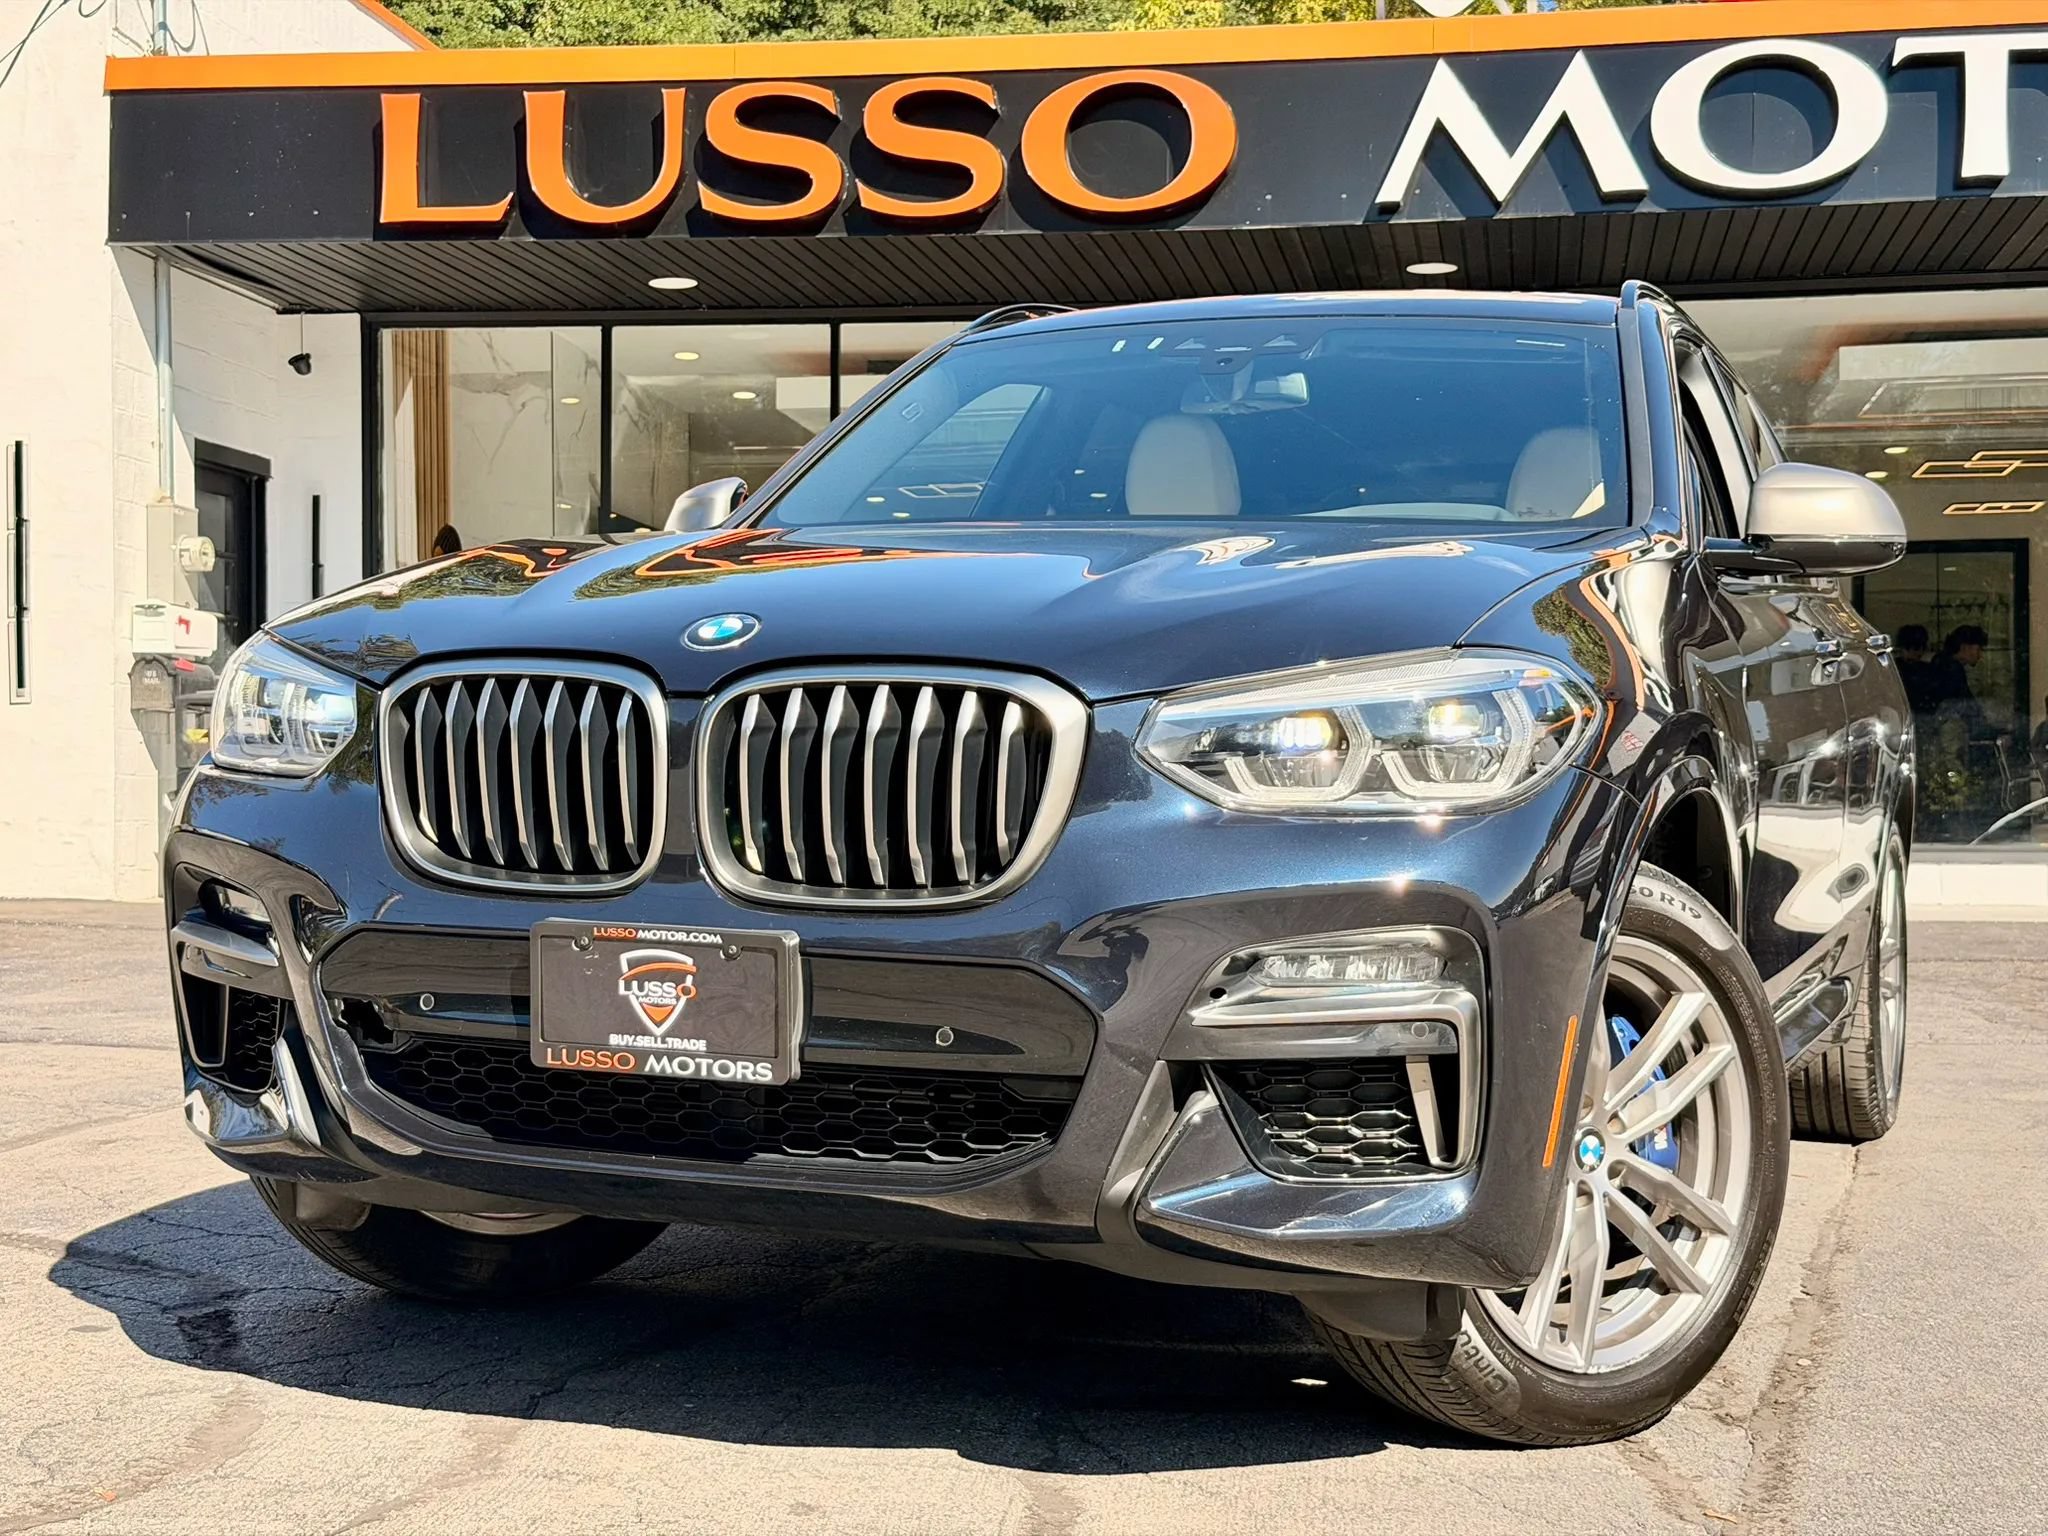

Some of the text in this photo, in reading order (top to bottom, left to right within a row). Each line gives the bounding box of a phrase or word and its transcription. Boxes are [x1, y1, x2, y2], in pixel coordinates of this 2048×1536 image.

[380, 31, 2048, 224] LUSSO MOT
[1660, 891, 1702, 919] R19
[593, 926, 723, 944] LUSSOMOTOR.COM
[618, 979, 697, 998] LUSSO
[638, 996, 677, 1005] MOTORS
[609, 1033, 707, 1051] BUY.SELL.TRADE
[546, 1048, 773, 1081] LUSSO MOTORS
